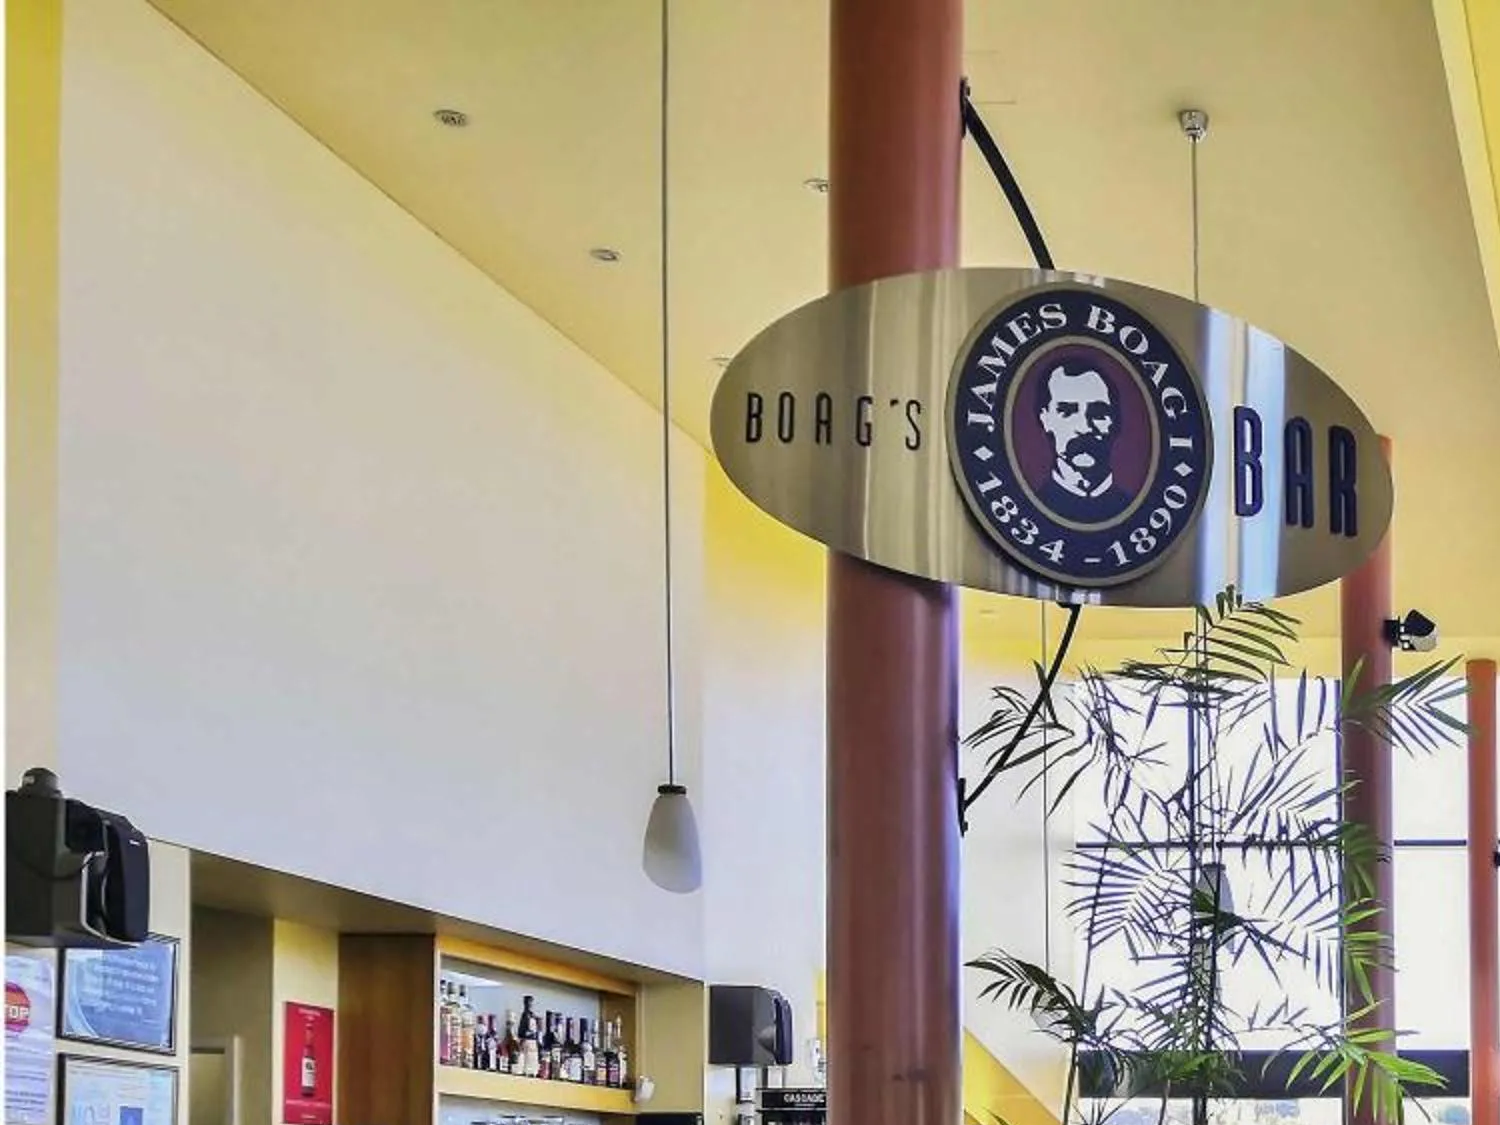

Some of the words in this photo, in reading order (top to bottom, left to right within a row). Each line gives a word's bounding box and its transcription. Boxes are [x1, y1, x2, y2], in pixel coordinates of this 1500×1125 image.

[744, 390, 923, 451] BOAG'S
[966, 302, 1069, 434] JAMES
[1085, 303, 1189, 421] BOAG
[972, 469, 1067, 567] 1834
[1107, 484, 1189, 569] 1890
[1232, 405, 1358, 538] BAR
